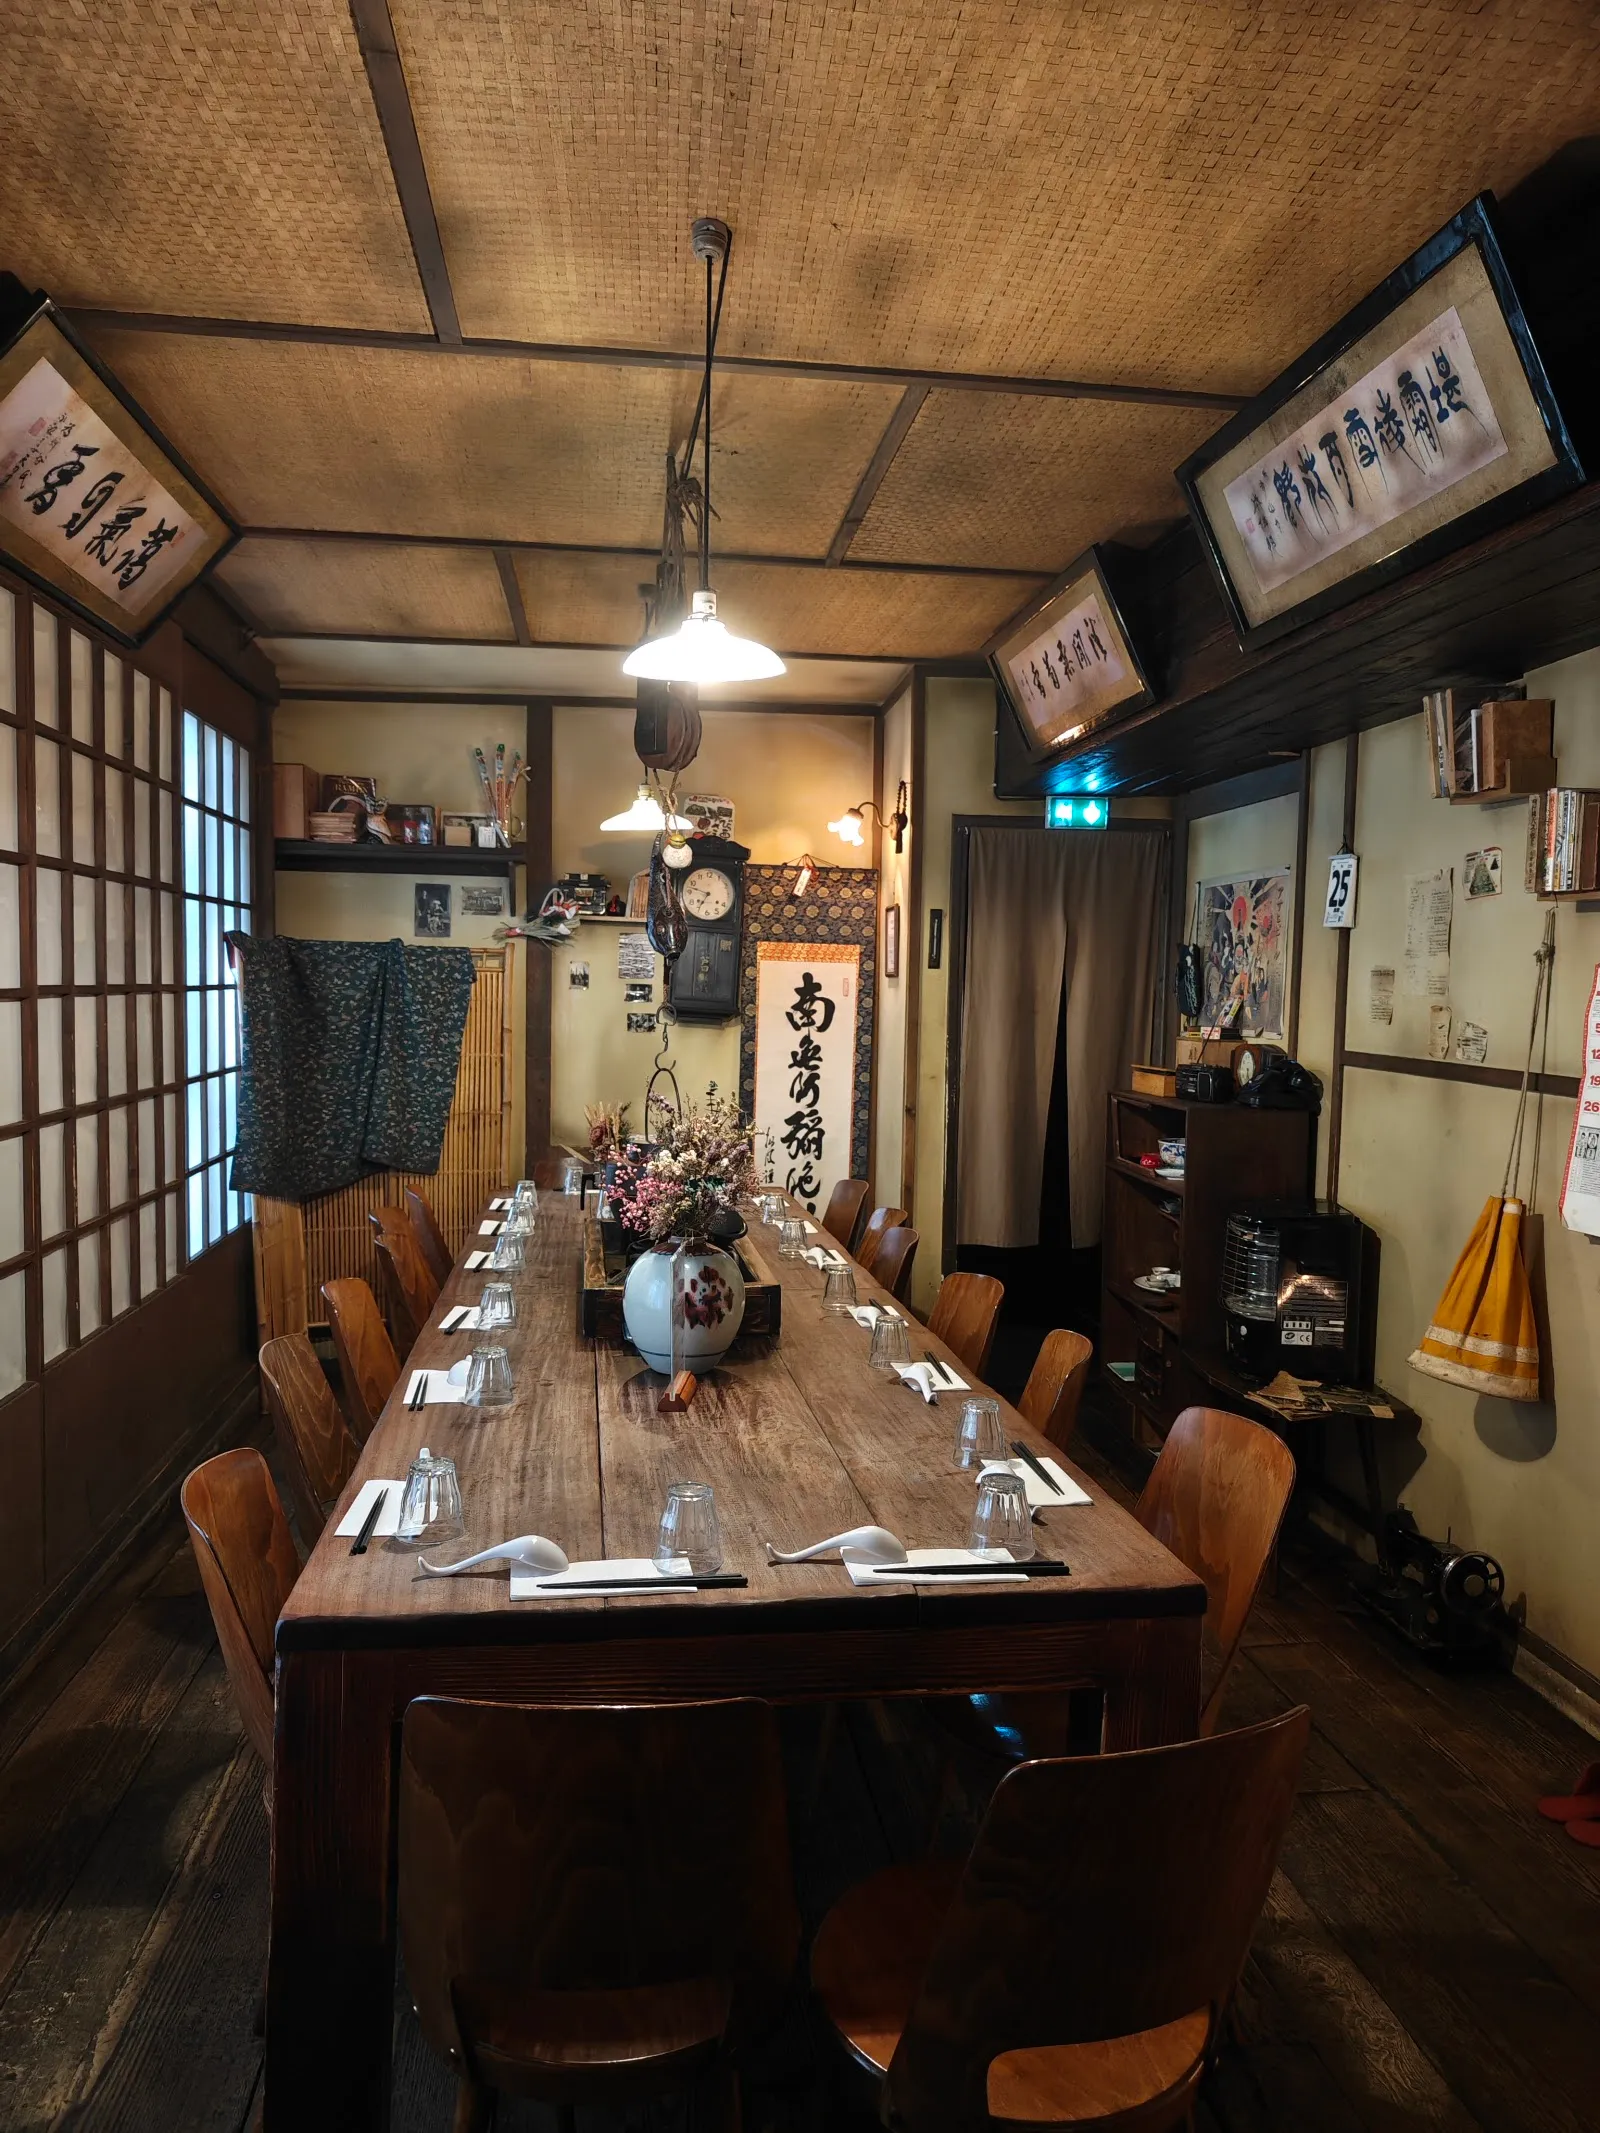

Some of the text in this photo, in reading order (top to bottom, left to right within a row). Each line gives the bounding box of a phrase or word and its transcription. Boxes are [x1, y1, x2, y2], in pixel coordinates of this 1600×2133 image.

[1328, 869, 1351, 908] 25
[1591, 1049, 1600, 1059] 12
[1590, 1075, 1600, 1086] 19
[1584, 1101, 1599, 1112] 26
[1300, 1335, 1311, 1343] CE
